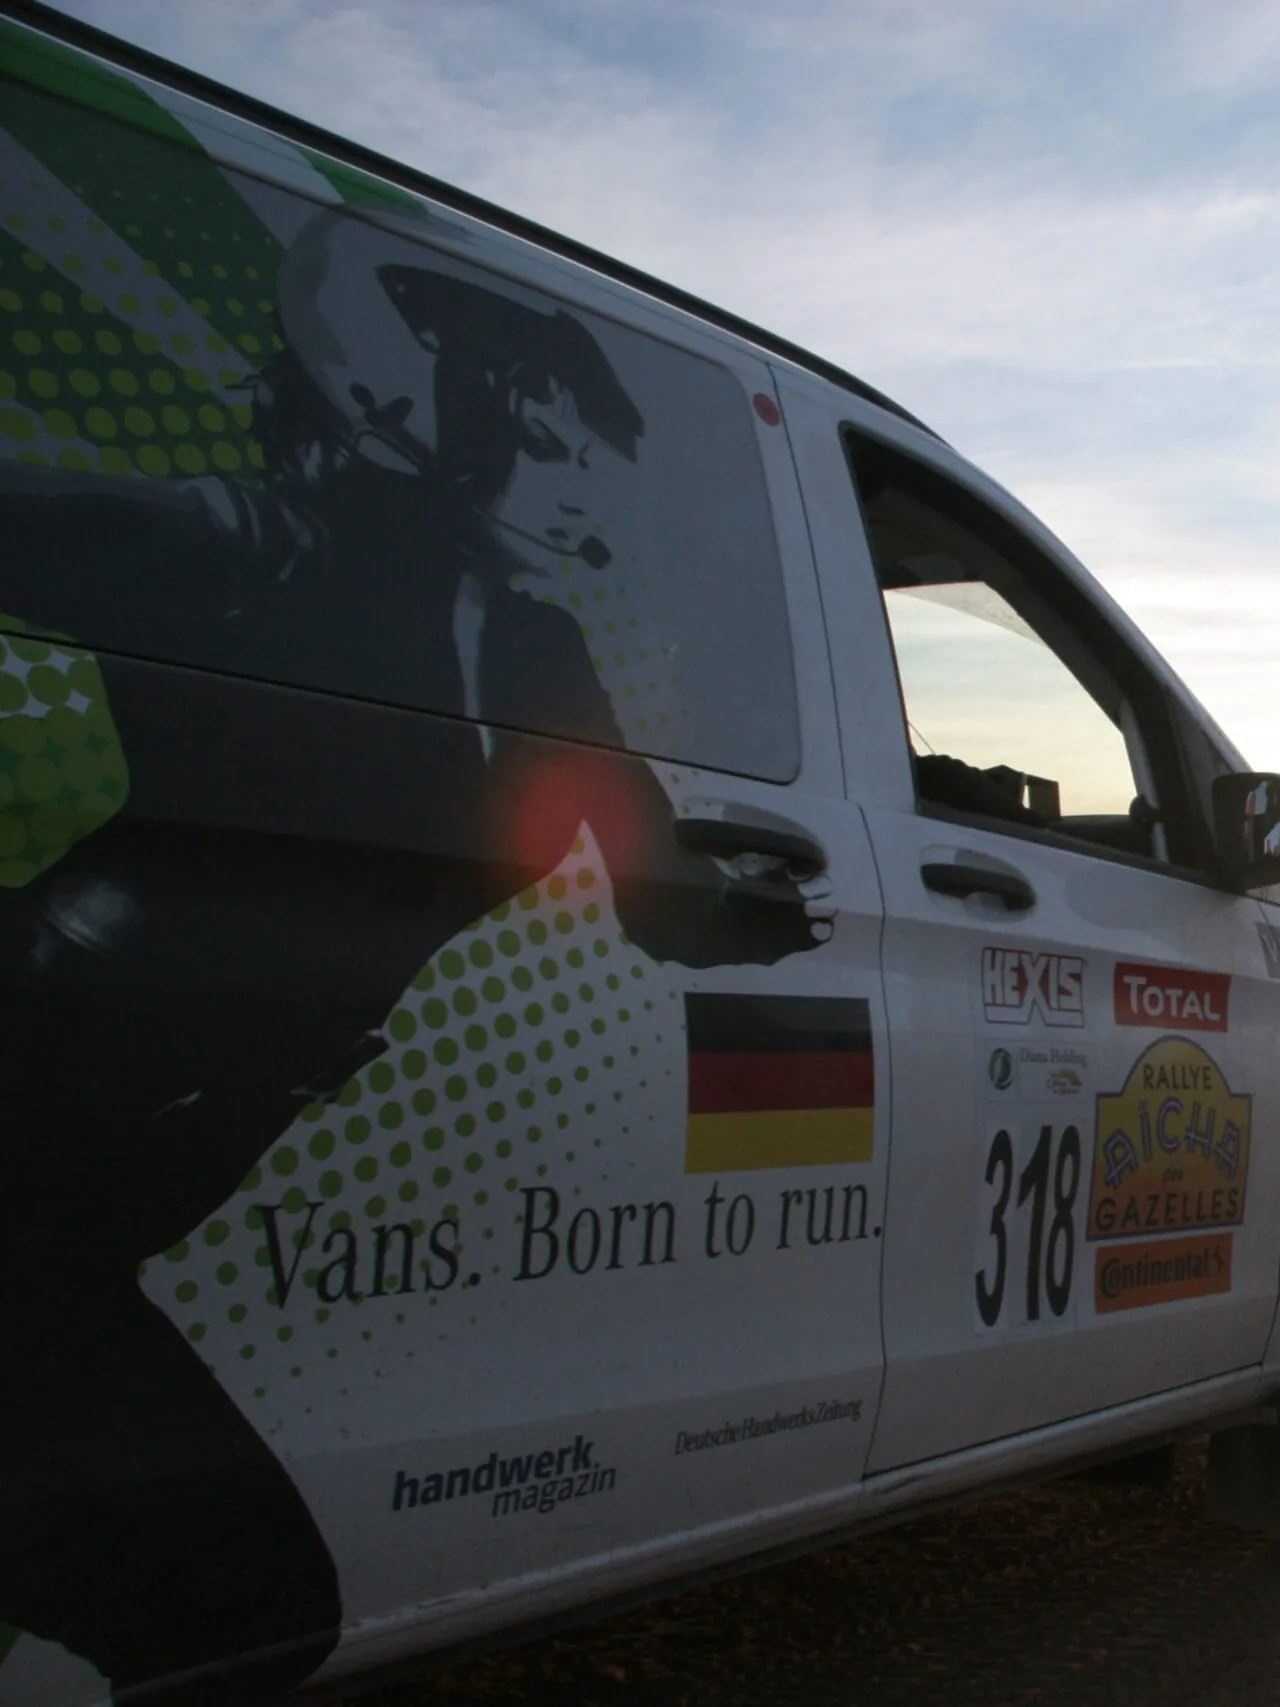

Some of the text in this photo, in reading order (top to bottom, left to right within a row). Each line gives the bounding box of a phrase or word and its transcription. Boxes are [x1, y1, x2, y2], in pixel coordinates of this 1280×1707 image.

[982, 946, 1085, 1027] HEXIS
[1122, 974, 1222, 1021] TOTAL
[1142, 1063, 1213, 1092] RALLYE
[974, 1124, 1082, 1328] 318
[1094, 1187, 1240, 1232] GAZELLES
[256, 1179, 883, 1310] Vans. Born to run.
[1099, 1246, 1211, 1299] Continental
[391, 1434, 596, 1512] handwerk
[491, 1461, 617, 1518] magazin
